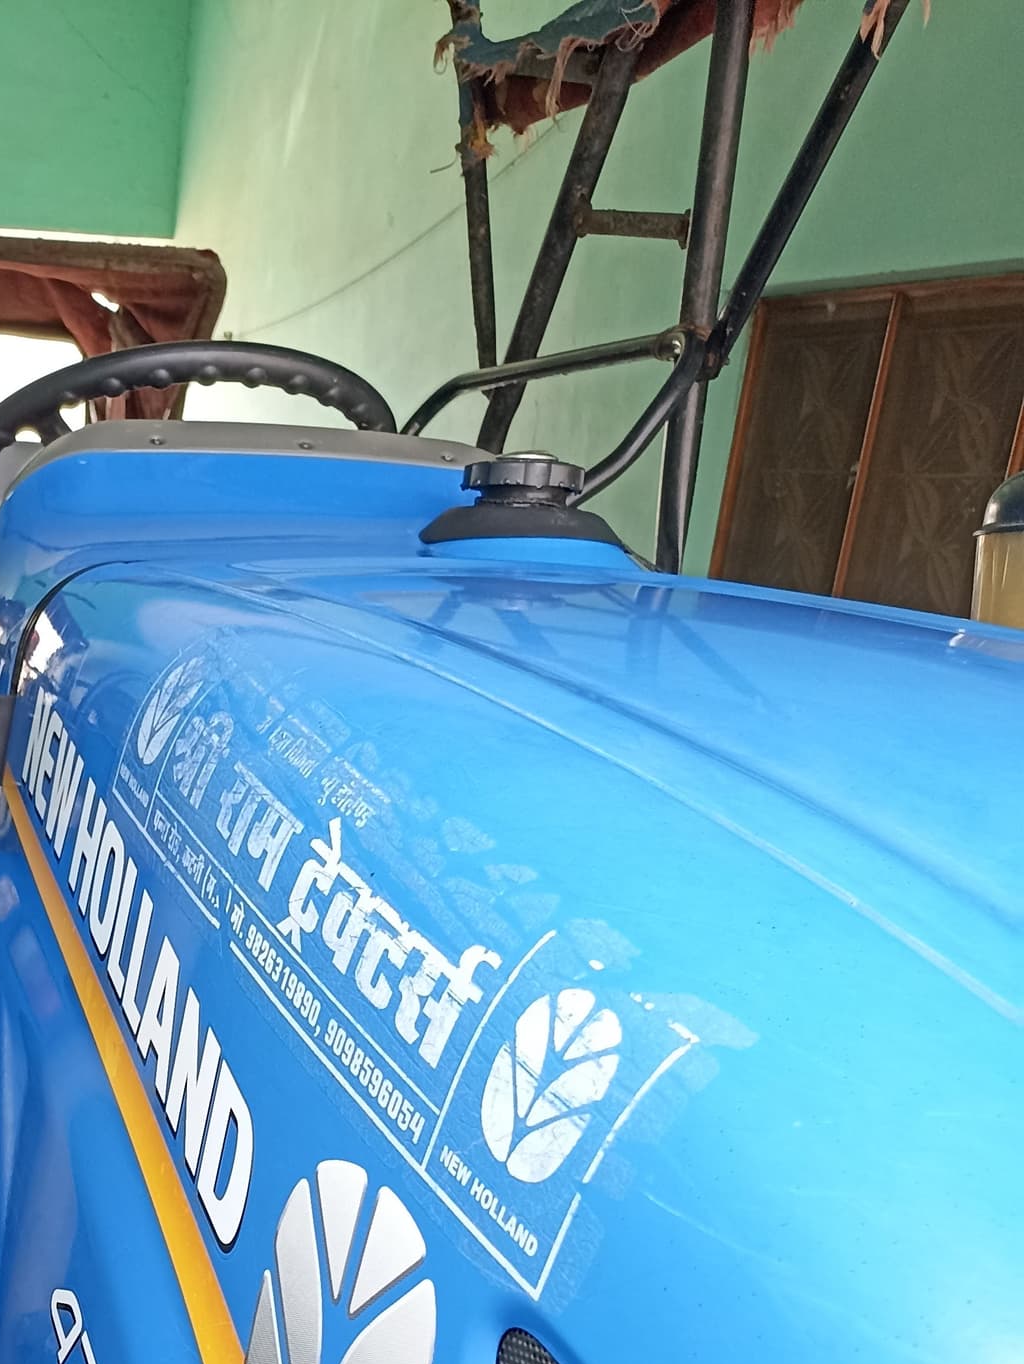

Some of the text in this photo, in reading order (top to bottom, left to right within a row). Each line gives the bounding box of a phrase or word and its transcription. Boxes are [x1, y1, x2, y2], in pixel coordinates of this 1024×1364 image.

[173, 711, 234, 810] श्री
[216, 761, 305, 892] राम
[22, 686, 255, 1254] NEW HOLLAND
[244, 928, 322, 1037] 9826319890,
[324, 1023, 426, 1145] 9098596054
[439, 1145, 539, 1257] NEW HOLLAND
